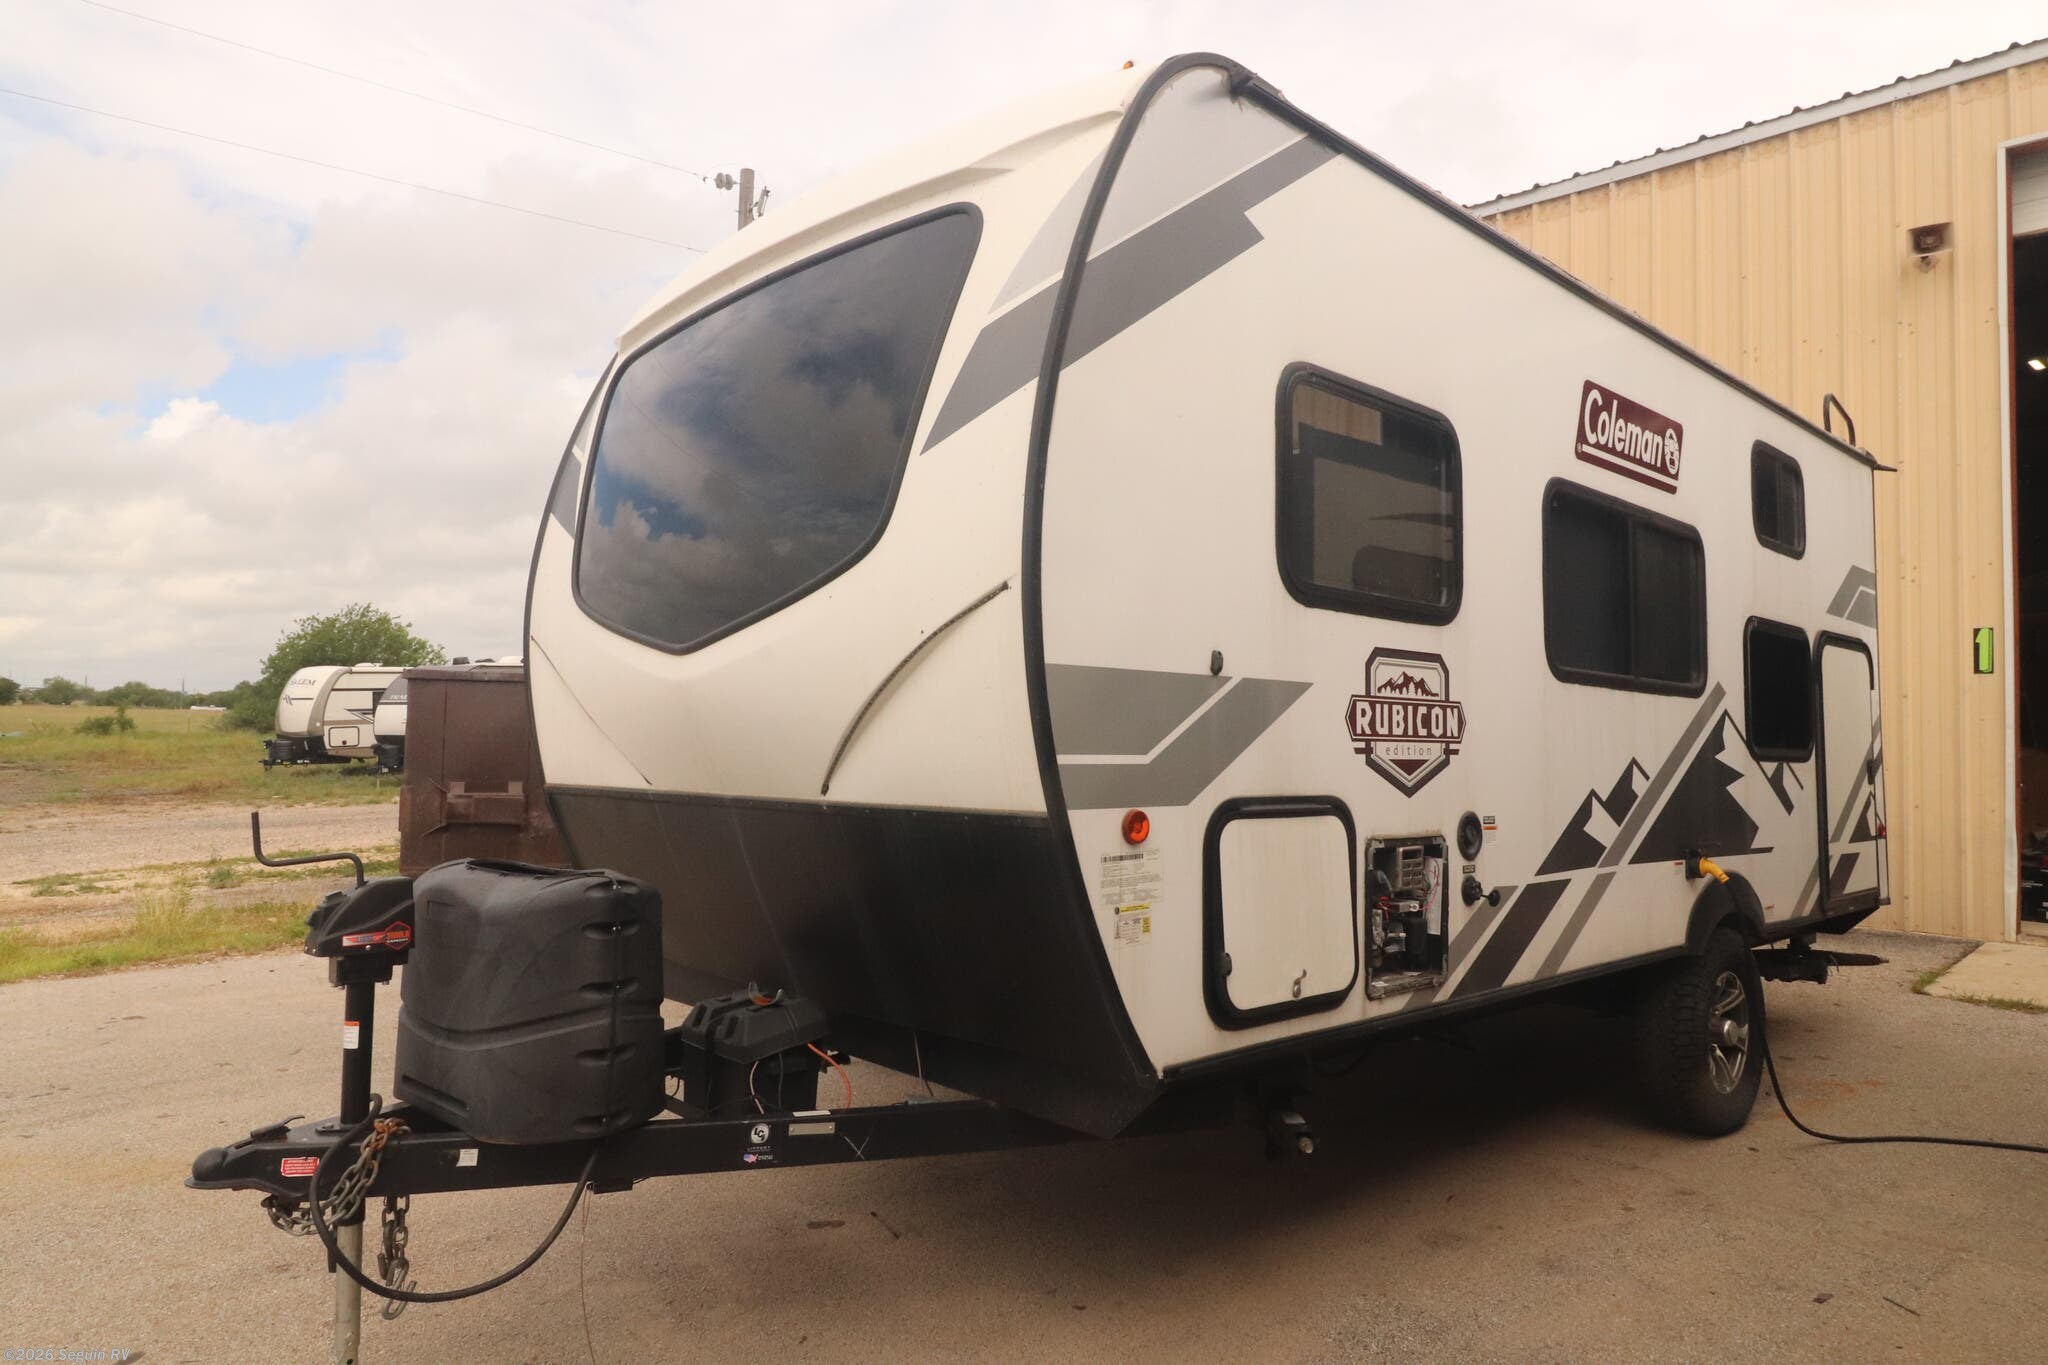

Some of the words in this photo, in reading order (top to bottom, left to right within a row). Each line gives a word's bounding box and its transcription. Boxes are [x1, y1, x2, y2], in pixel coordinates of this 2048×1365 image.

[1584, 389, 1664, 468] Coleman
[1975, 627, 1993, 673] 1
[1355, 701, 1459, 738] RUBICON
[1385, 746, 1432, 756] edition
